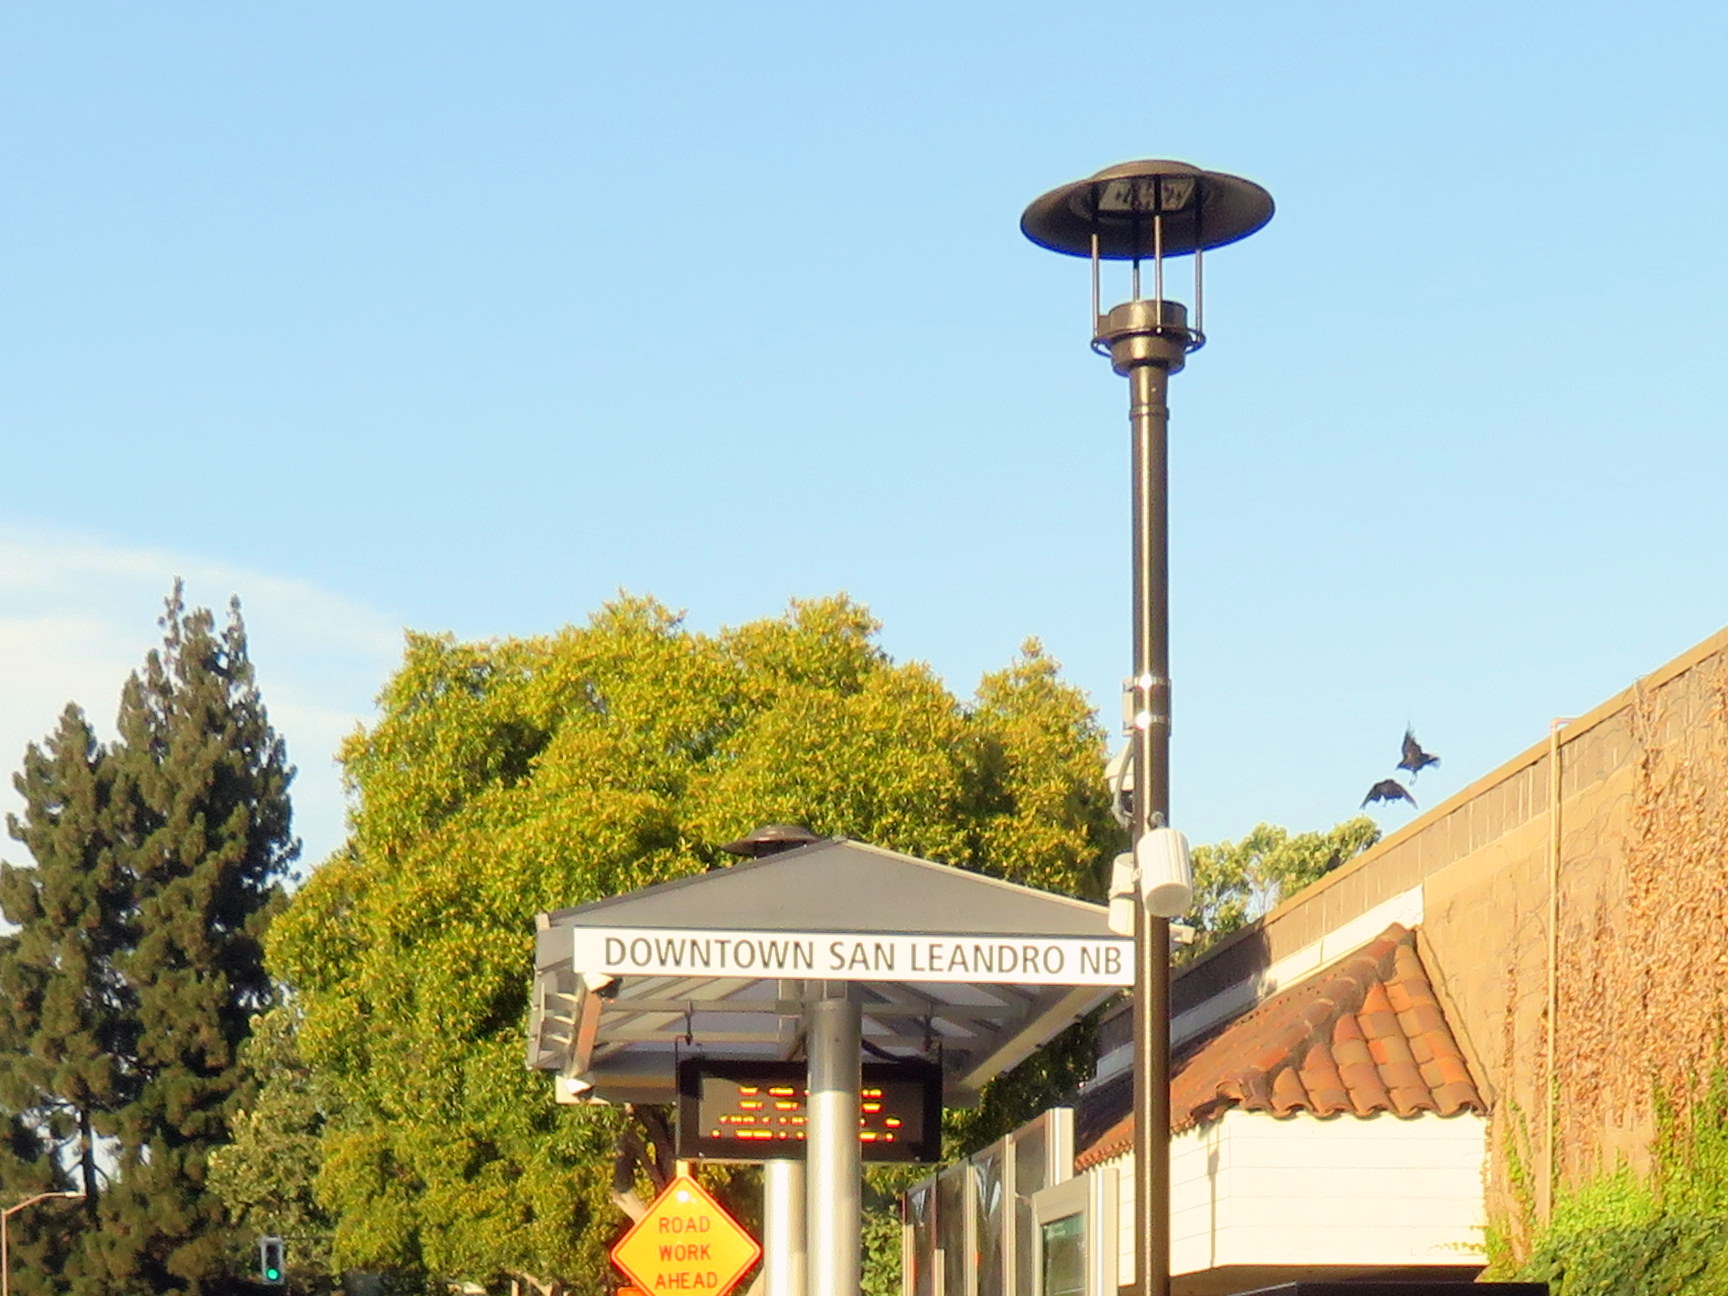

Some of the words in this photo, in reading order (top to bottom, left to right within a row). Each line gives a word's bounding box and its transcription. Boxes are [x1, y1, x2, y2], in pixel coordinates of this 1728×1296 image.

[604, 937, 814, 969] DOWNTOWN
[829, 941, 895, 972] SAN
[910, 943, 1065, 975] LEANDRO
[1080, 946, 1122, 976] NB
[658, 1215, 711, 1233] ROAD
[658, 1243, 711, 1262] WORK
[654, 1271, 718, 1290] AHEAD
